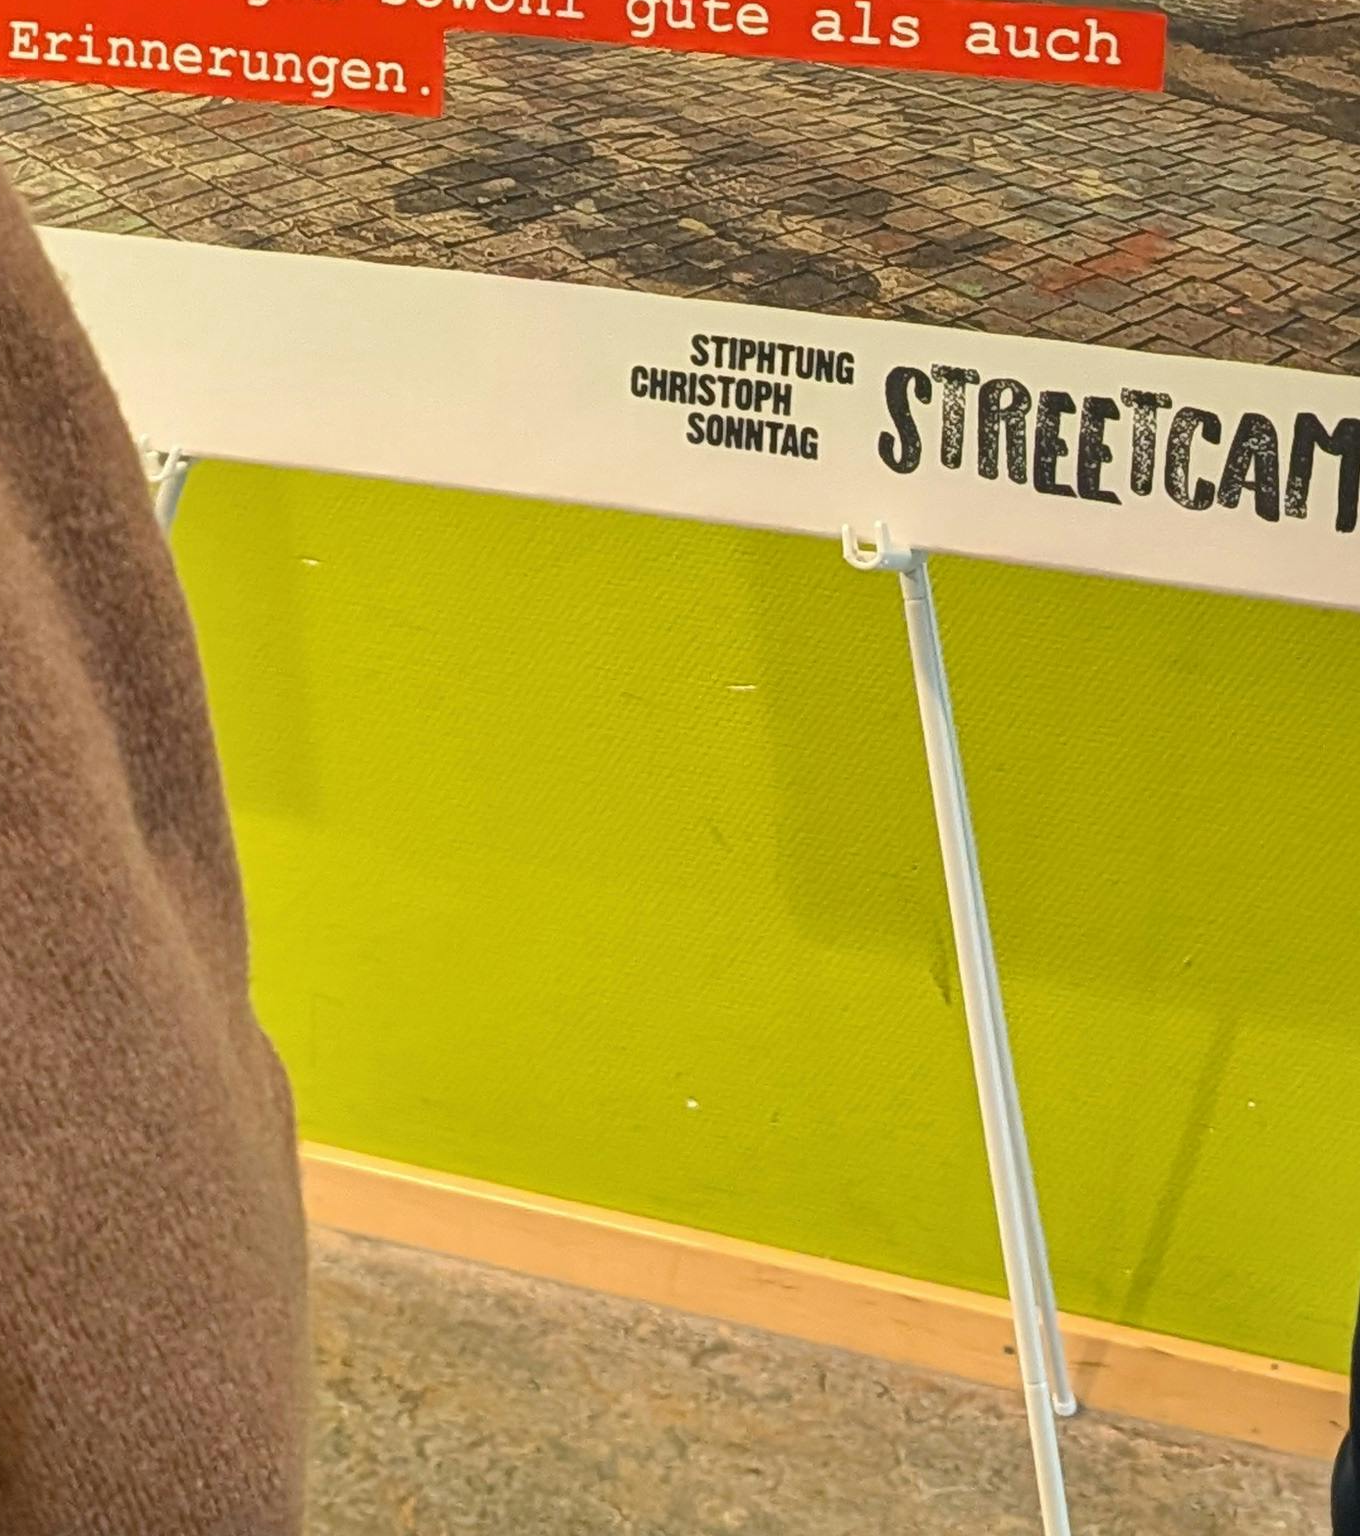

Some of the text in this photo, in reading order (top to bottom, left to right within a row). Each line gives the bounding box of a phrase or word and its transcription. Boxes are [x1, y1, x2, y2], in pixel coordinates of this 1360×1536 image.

[8, 20, 432, 98] Erinnerungen.
[811, 0, 921, 49] als
[964, 18, 1121, 66] auch
[689, 333, 856, 385] STIPHTUNG
[630, 364, 793, 416] CHRISTOPH
[686, 412, 820, 460] SONNTAG
